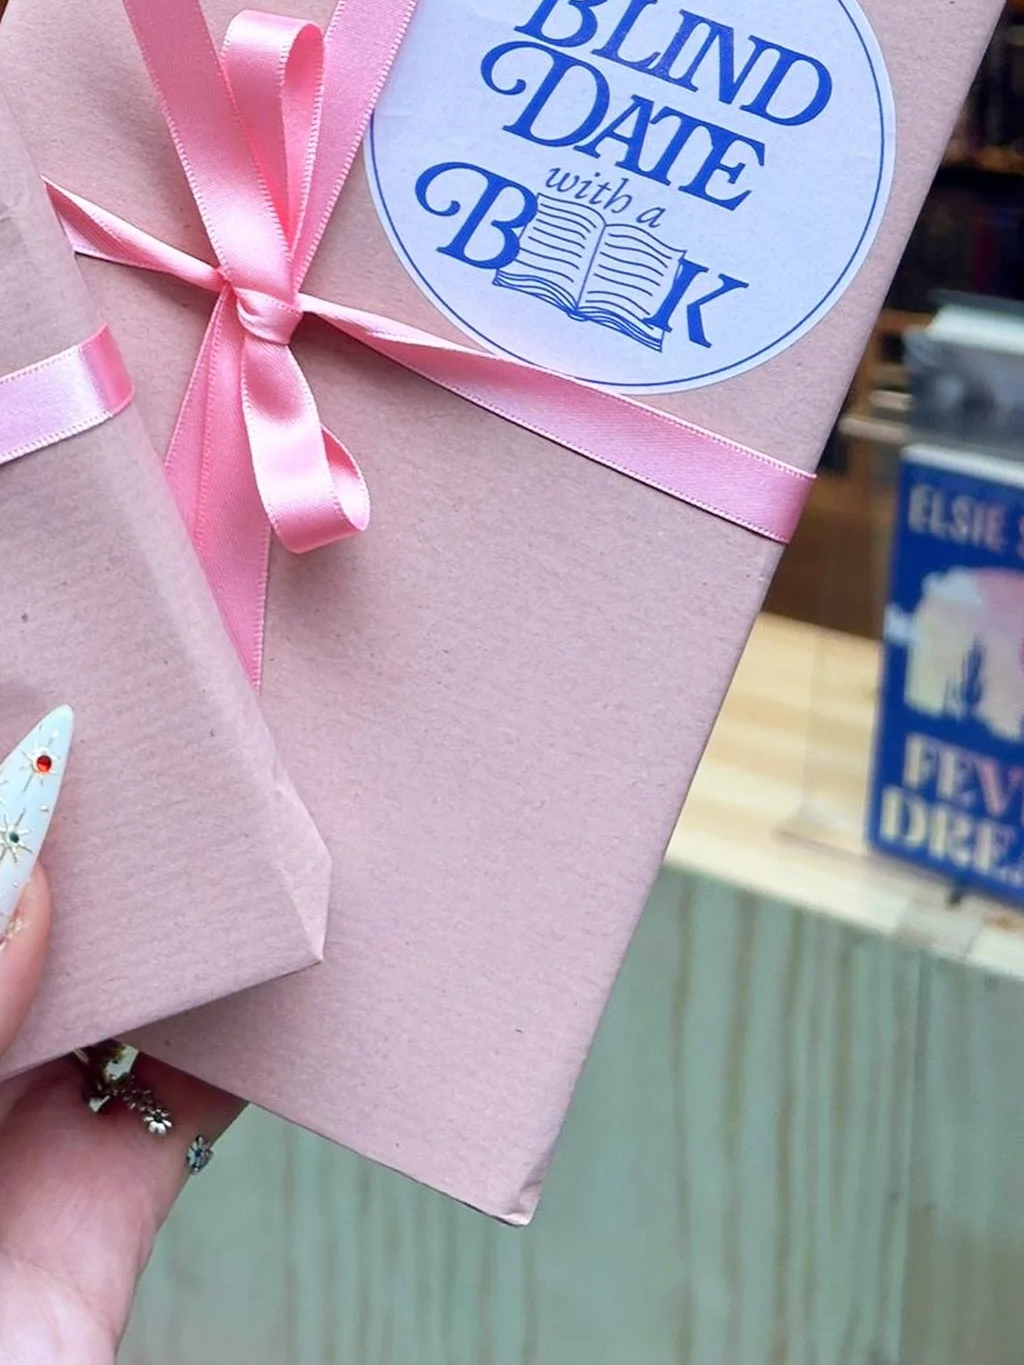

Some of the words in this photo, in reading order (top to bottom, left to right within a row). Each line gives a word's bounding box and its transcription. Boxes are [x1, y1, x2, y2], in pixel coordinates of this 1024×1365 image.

[479, 40, 766, 212] DATE
[544, 163, 633, 213] with
[636, 205, 662, 229] a
[413, 161, 750, 352] BK
[908, 484, 1008, 554] ELSIE
[902, 732, 1024, 826] FEV
[879, 784, 1024, 886] DRE
